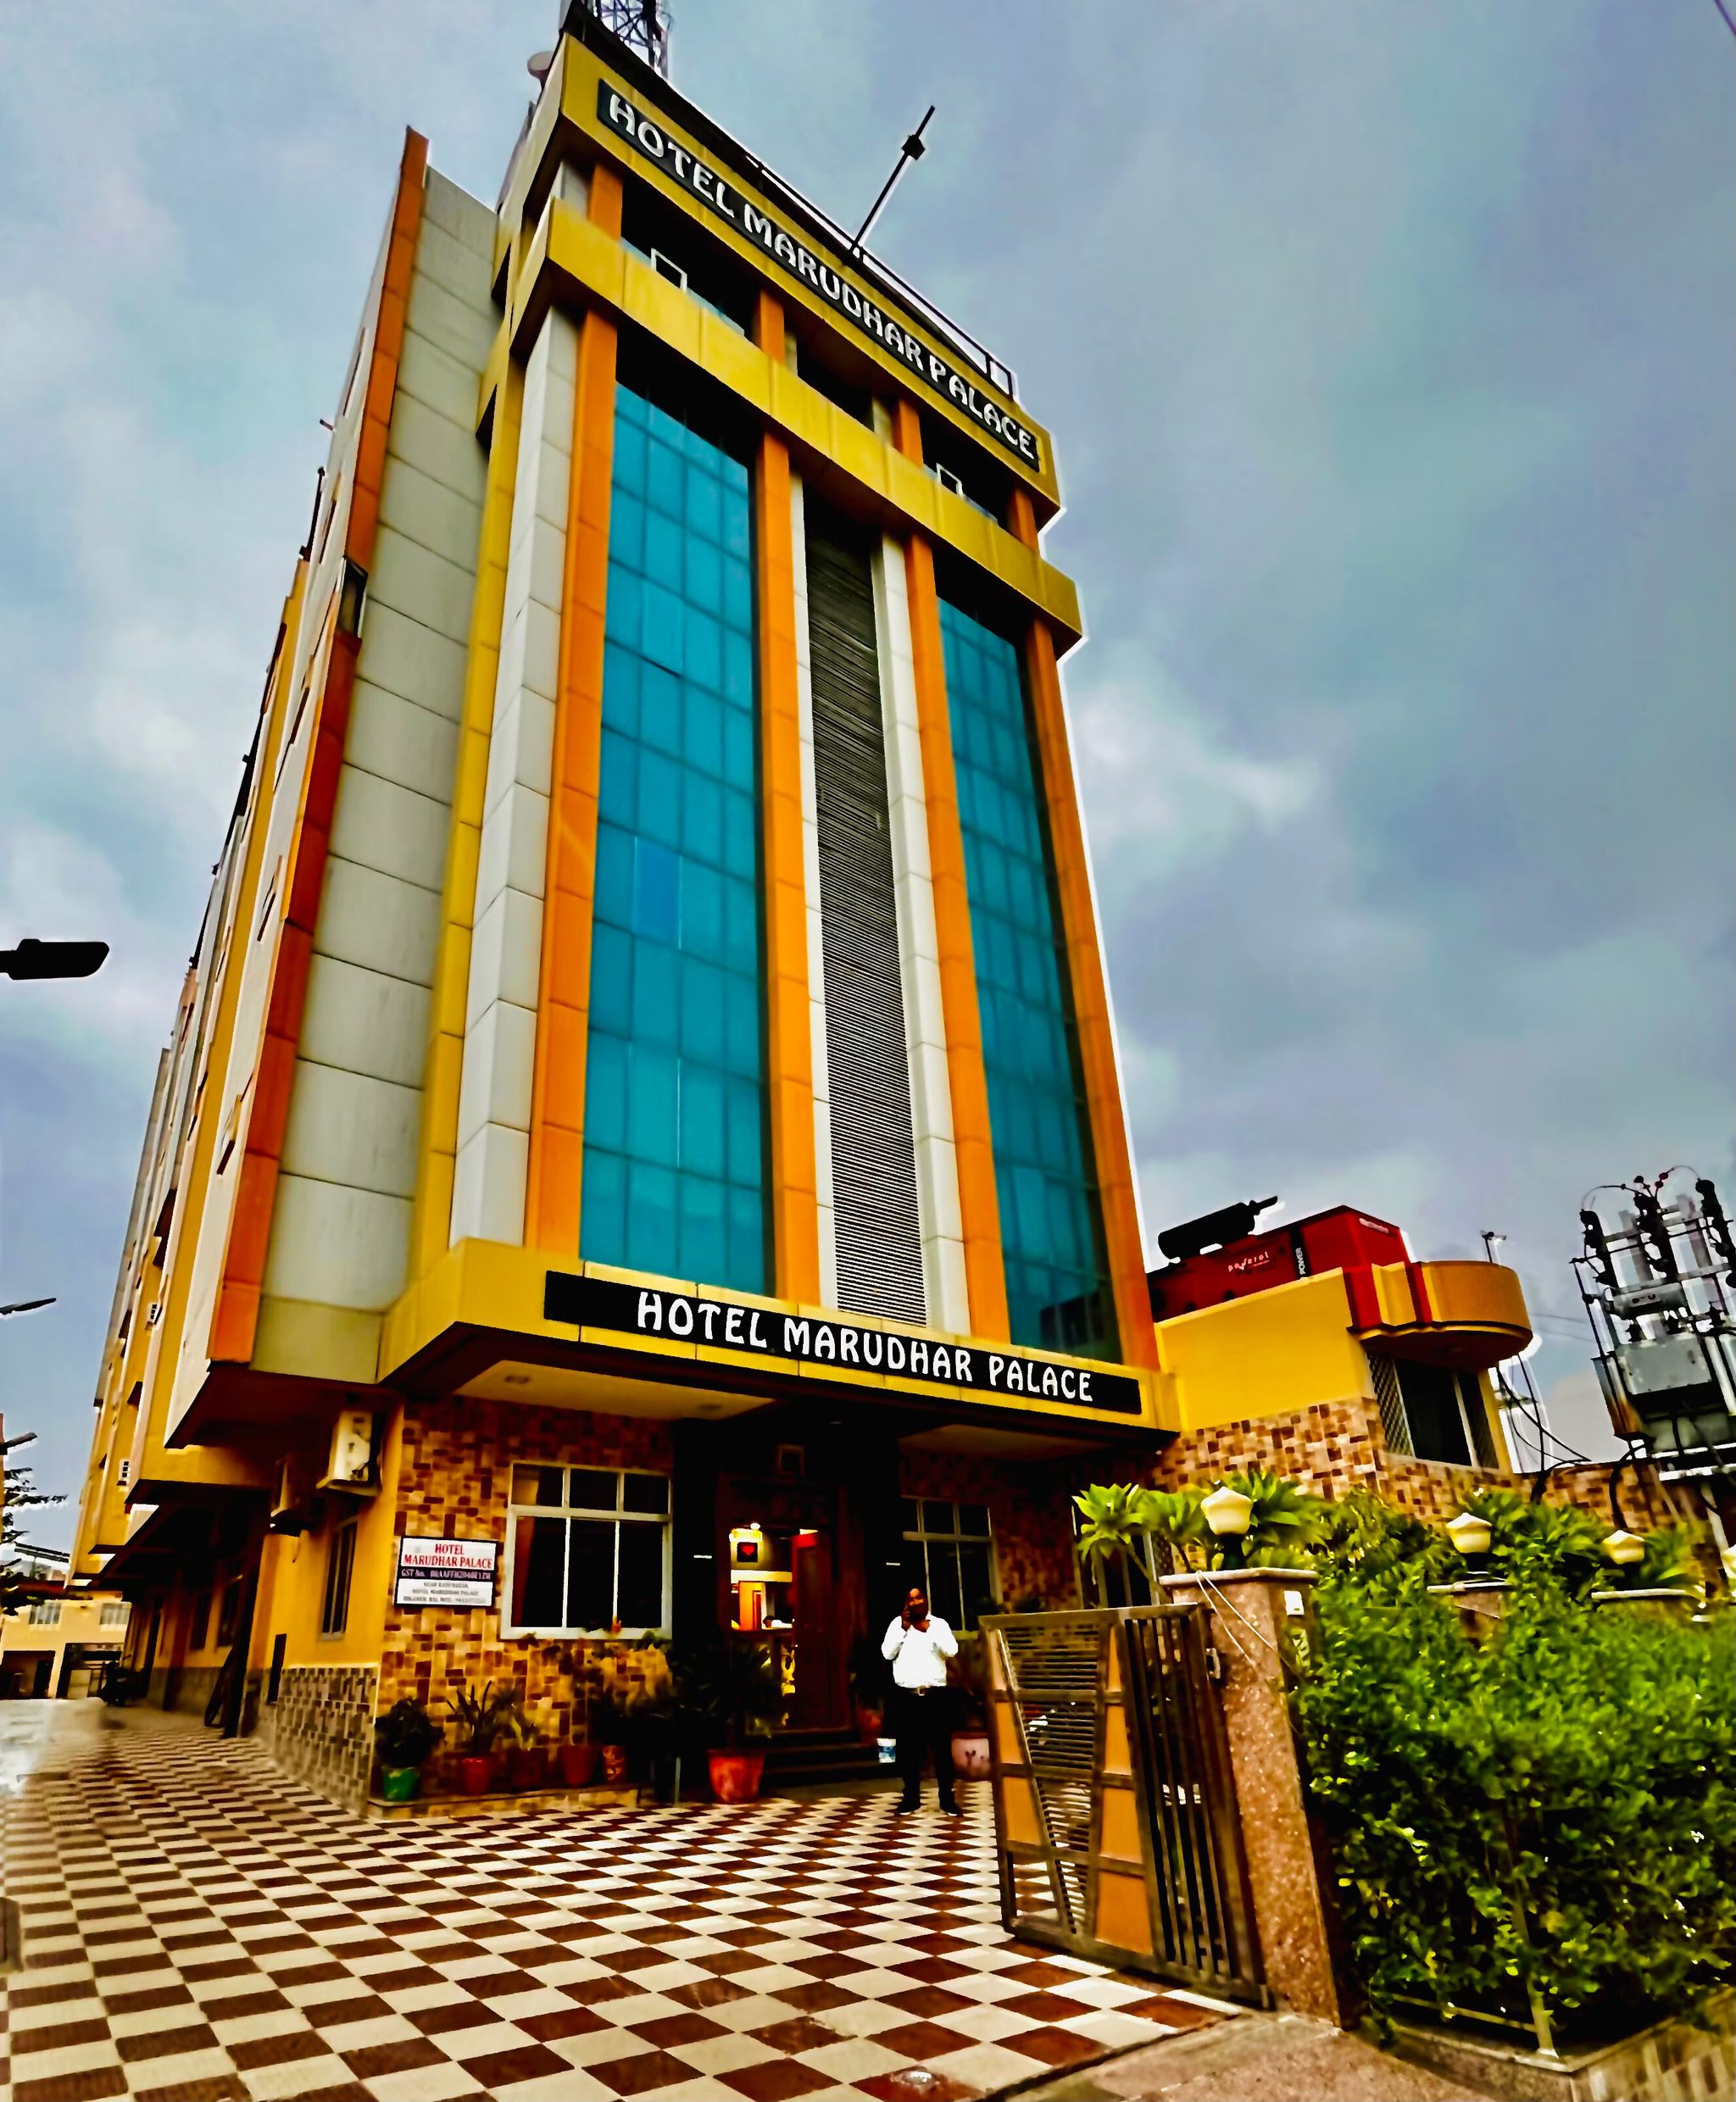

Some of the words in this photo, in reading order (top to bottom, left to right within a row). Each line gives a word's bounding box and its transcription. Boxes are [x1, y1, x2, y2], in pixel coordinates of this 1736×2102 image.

[609, 93, 735, 219] HOTEL
[743, 203, 924, 371] MARUDHAR
[929, 354, 1035, 459] PALACE
[637, 1291, 767, 1349] HOTEL
[783, 1315, 973, 1382] MARUDHAR
[988, 1354, 1093, 1402] PALACE
[435, 1543, 465, 1555] HOTEL
[403, 1554, 458, 1567] MARUDHAR
[459, 1557, 492, 1569] PALACE
[401, 1568, 415, 1576] GST
